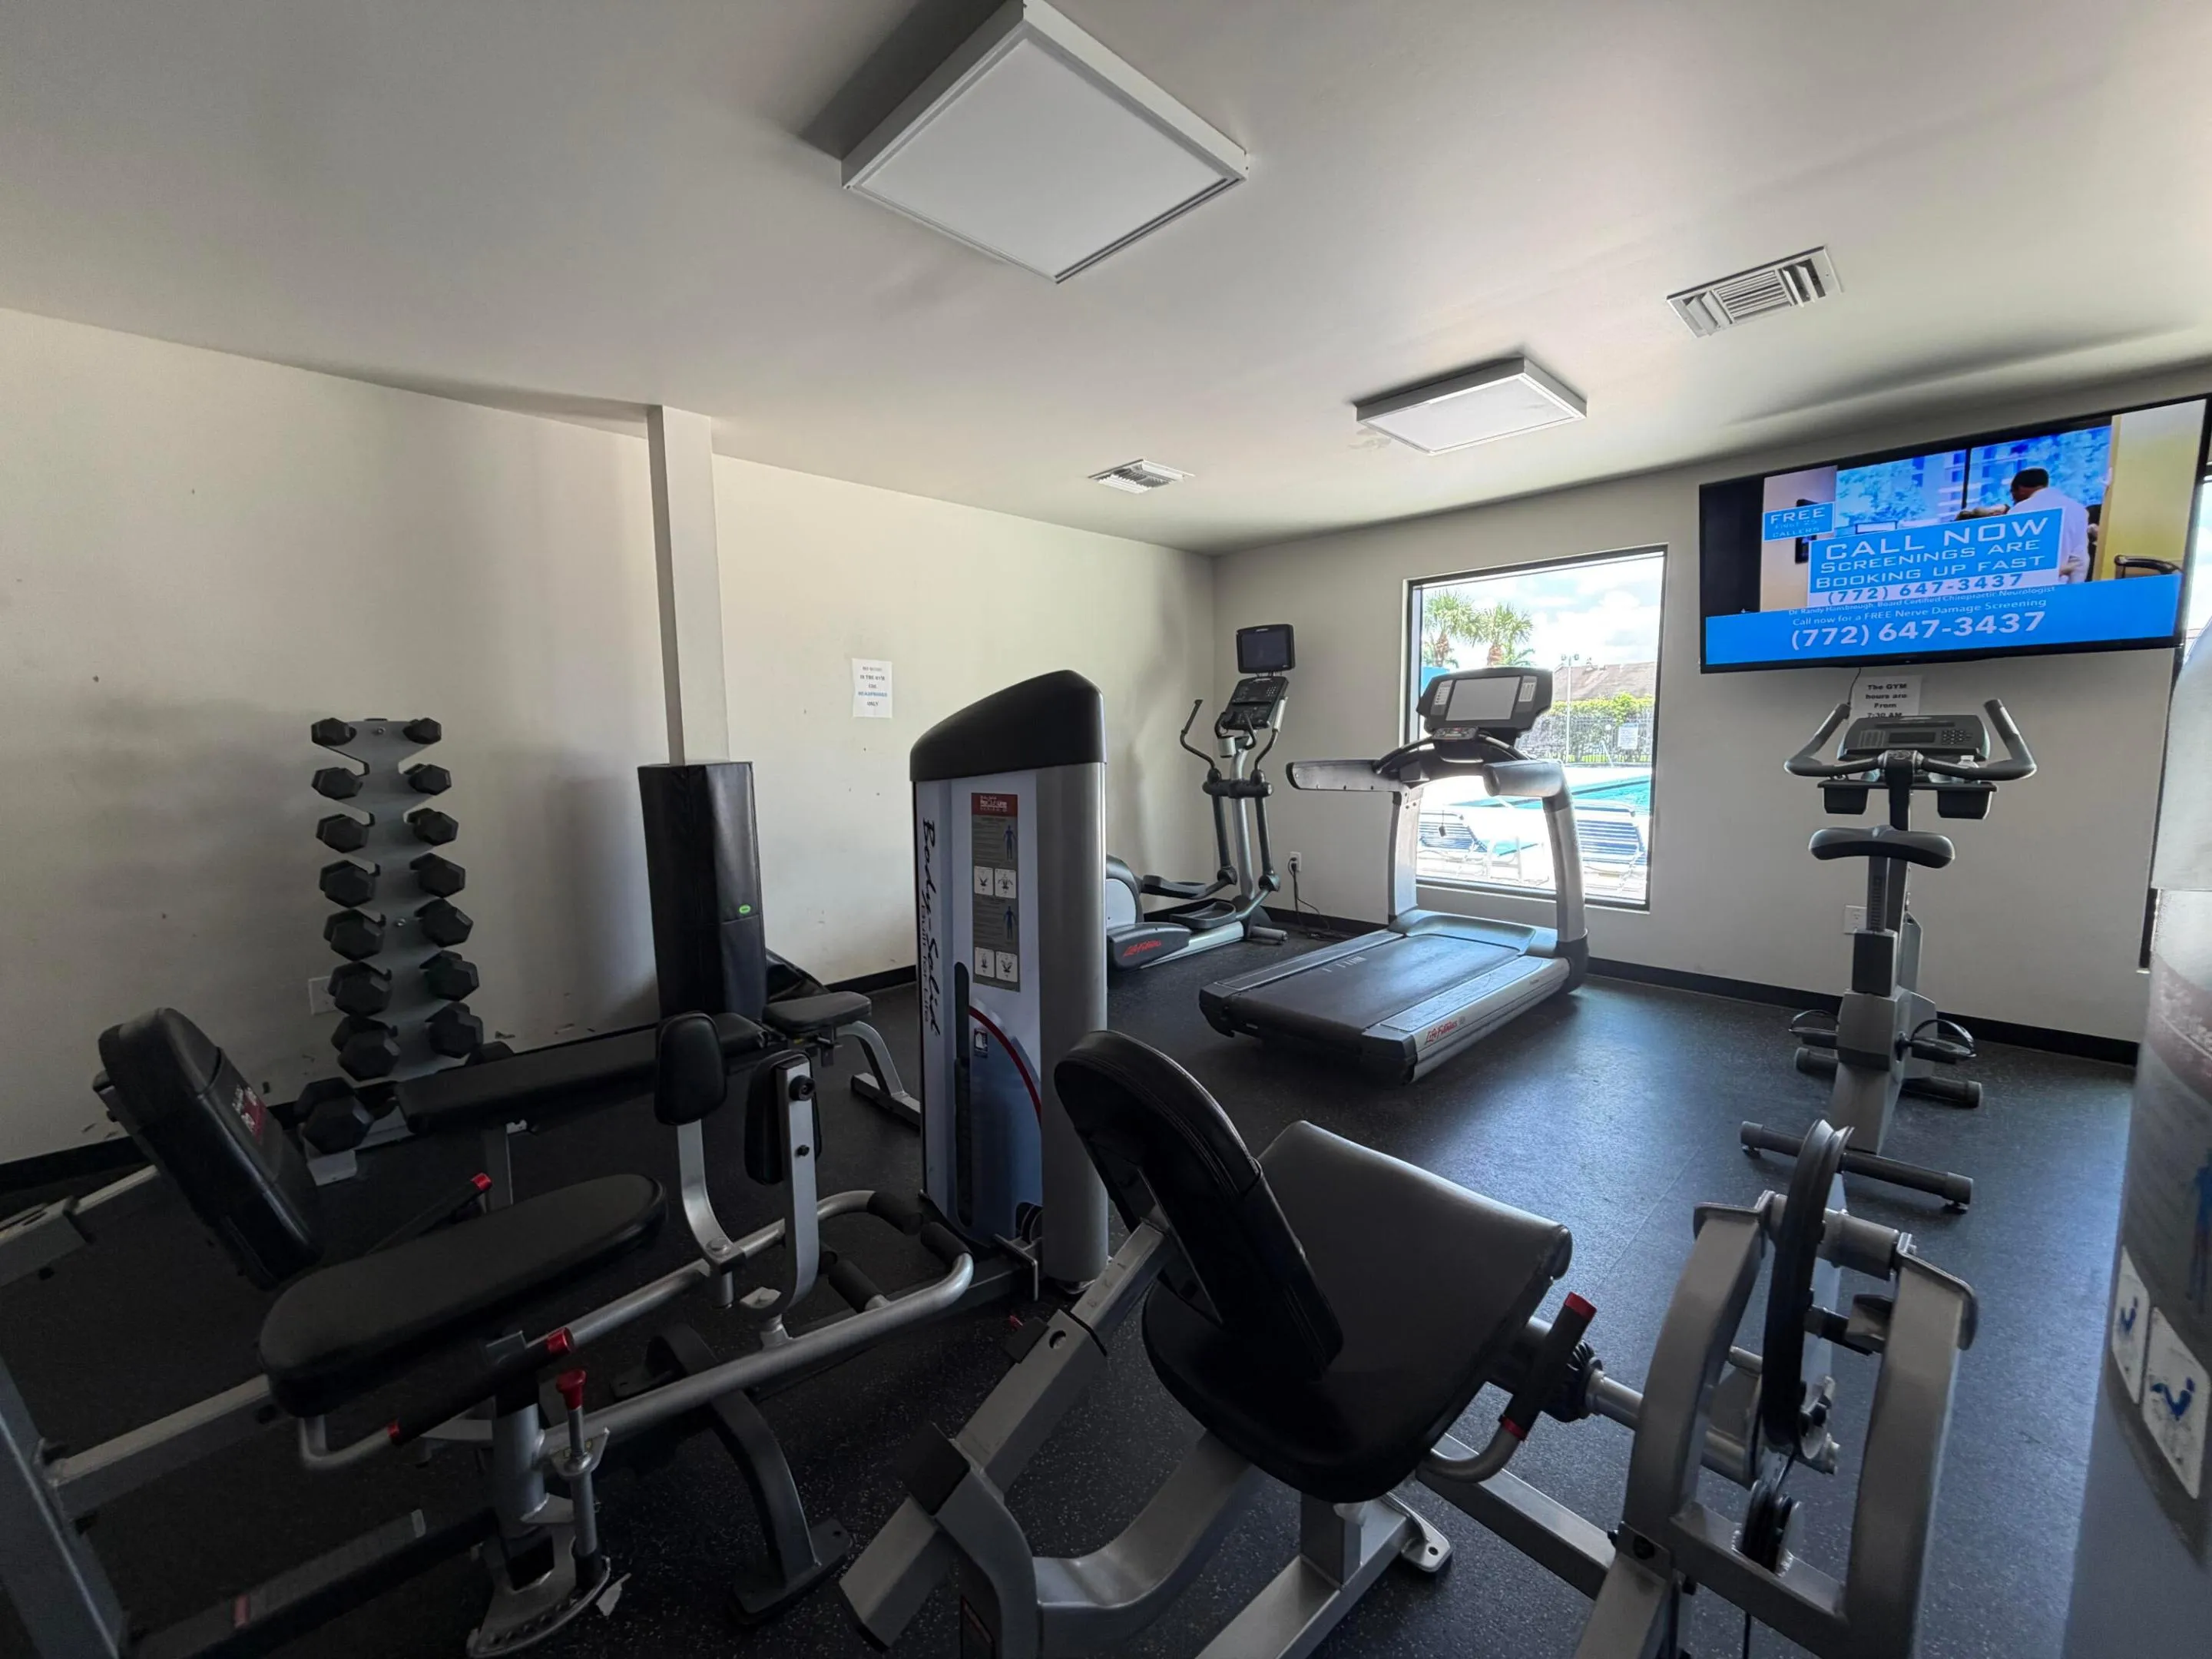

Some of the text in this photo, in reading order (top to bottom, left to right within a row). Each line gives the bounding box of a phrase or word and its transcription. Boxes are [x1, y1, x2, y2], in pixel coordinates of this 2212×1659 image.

[1770, 507, 1826, 525] FREE
[1773, 527, 1820, 538] CALLERS
[1826, 517, 2048, 561] CALL NOW
[1816, 555, 2045, 589] BOOKING UP FAST
[1820, 540, 2041, 574] SCREENINGS ARE
[1828, 573, 2024, 604] (772) 647-3437
[1904, 596, 1941, 605] Certified
[1942, 591, 1995, 602] Chiropractic
[1998, 586, 2055, 598] Neurologist
[1793, 617, 1812, 626] Call
[1864, 611, 1892, 620] FREE
[1896, 608, 1929, 618] Nerve
[1932, 604, 1982, 615] Damage
[1985, 598, 2047, 610] Screening
[1791, 611, 2045, 651] (772) 647-3437
